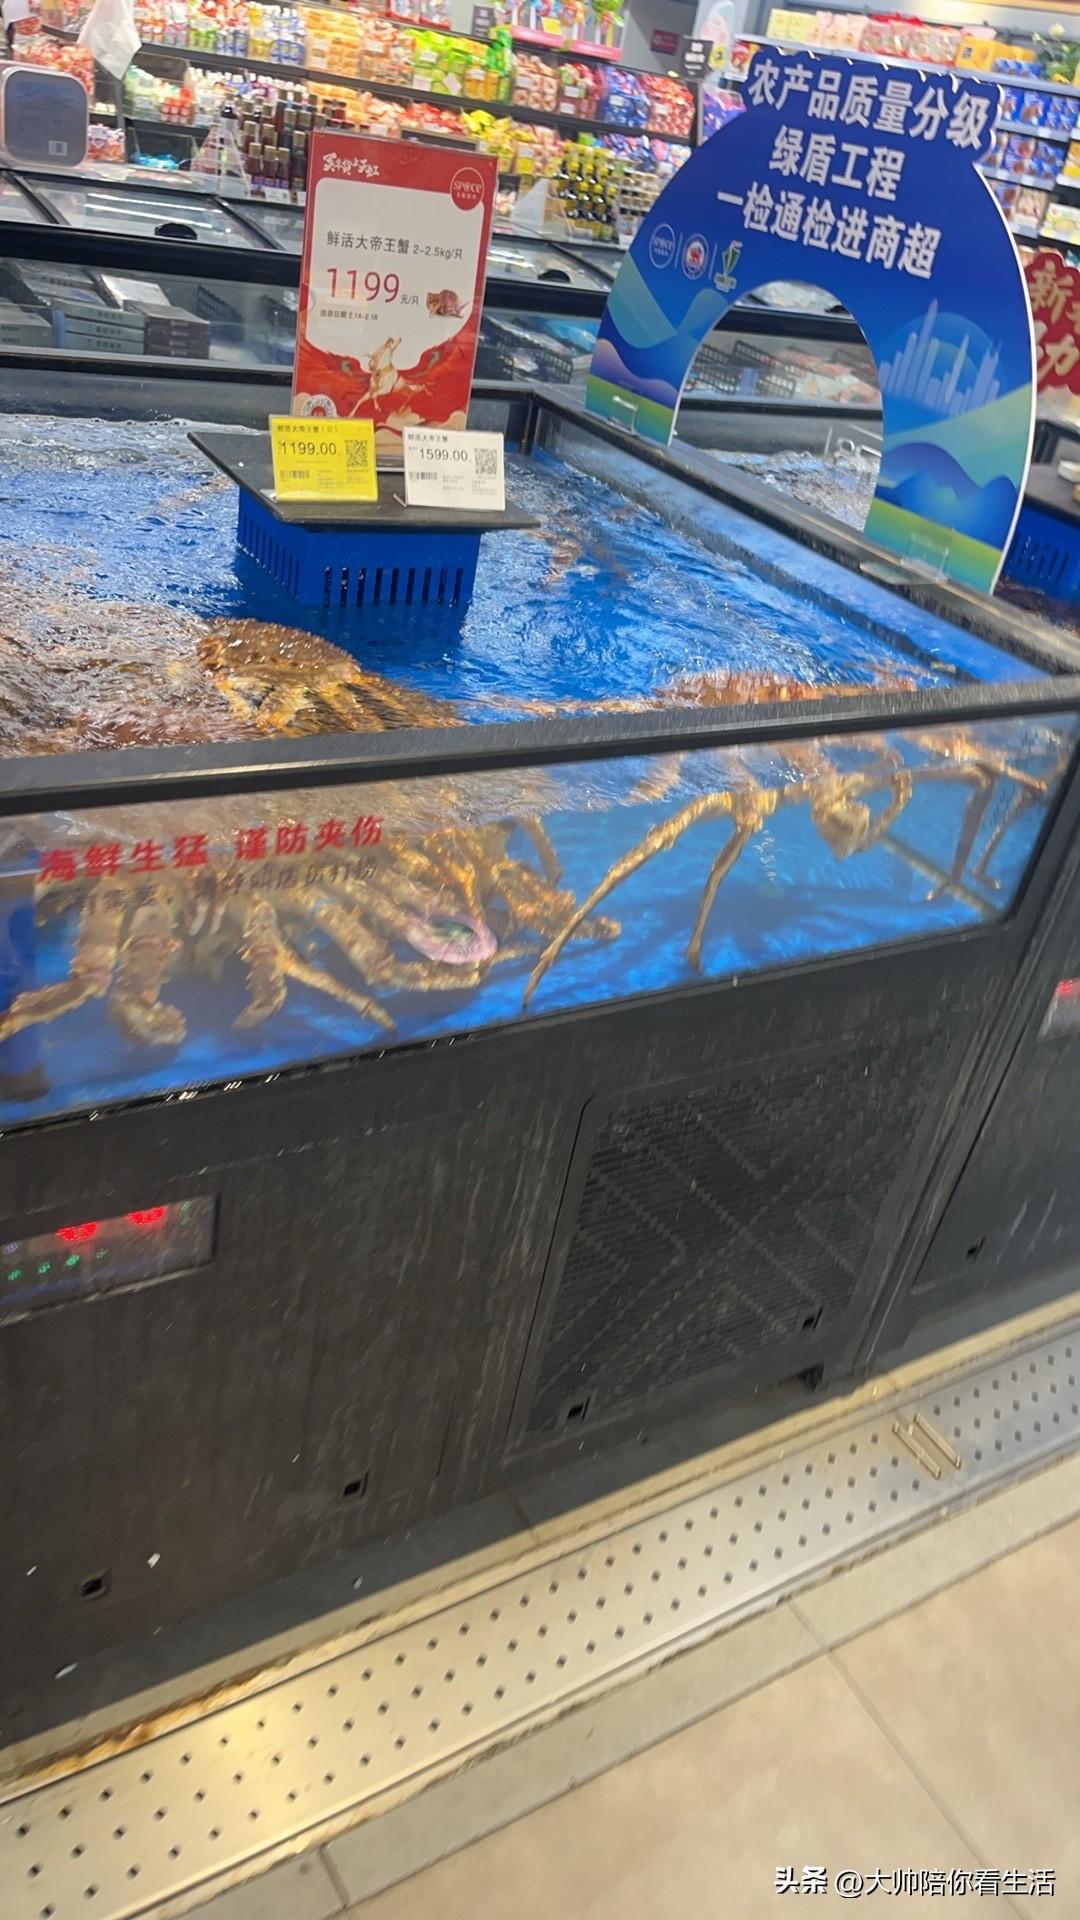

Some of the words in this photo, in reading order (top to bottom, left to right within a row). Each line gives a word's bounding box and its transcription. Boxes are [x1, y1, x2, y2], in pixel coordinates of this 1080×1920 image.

[748, 58, 991, 151] 农产品质量分级
[768, 125, 906, 202] 绿盾工程
[327, 230, 410, 255] 鲜活大帝王蟹
[717, 182, 943, 280] 一检通检进商超
[327, 267, 400, 303] 1199
[420, 447, 469, 462] 1599.00
[37, 832, 209, 884] 海鲜生猛
[235, 814, 385, 862] 谨防夹伤
